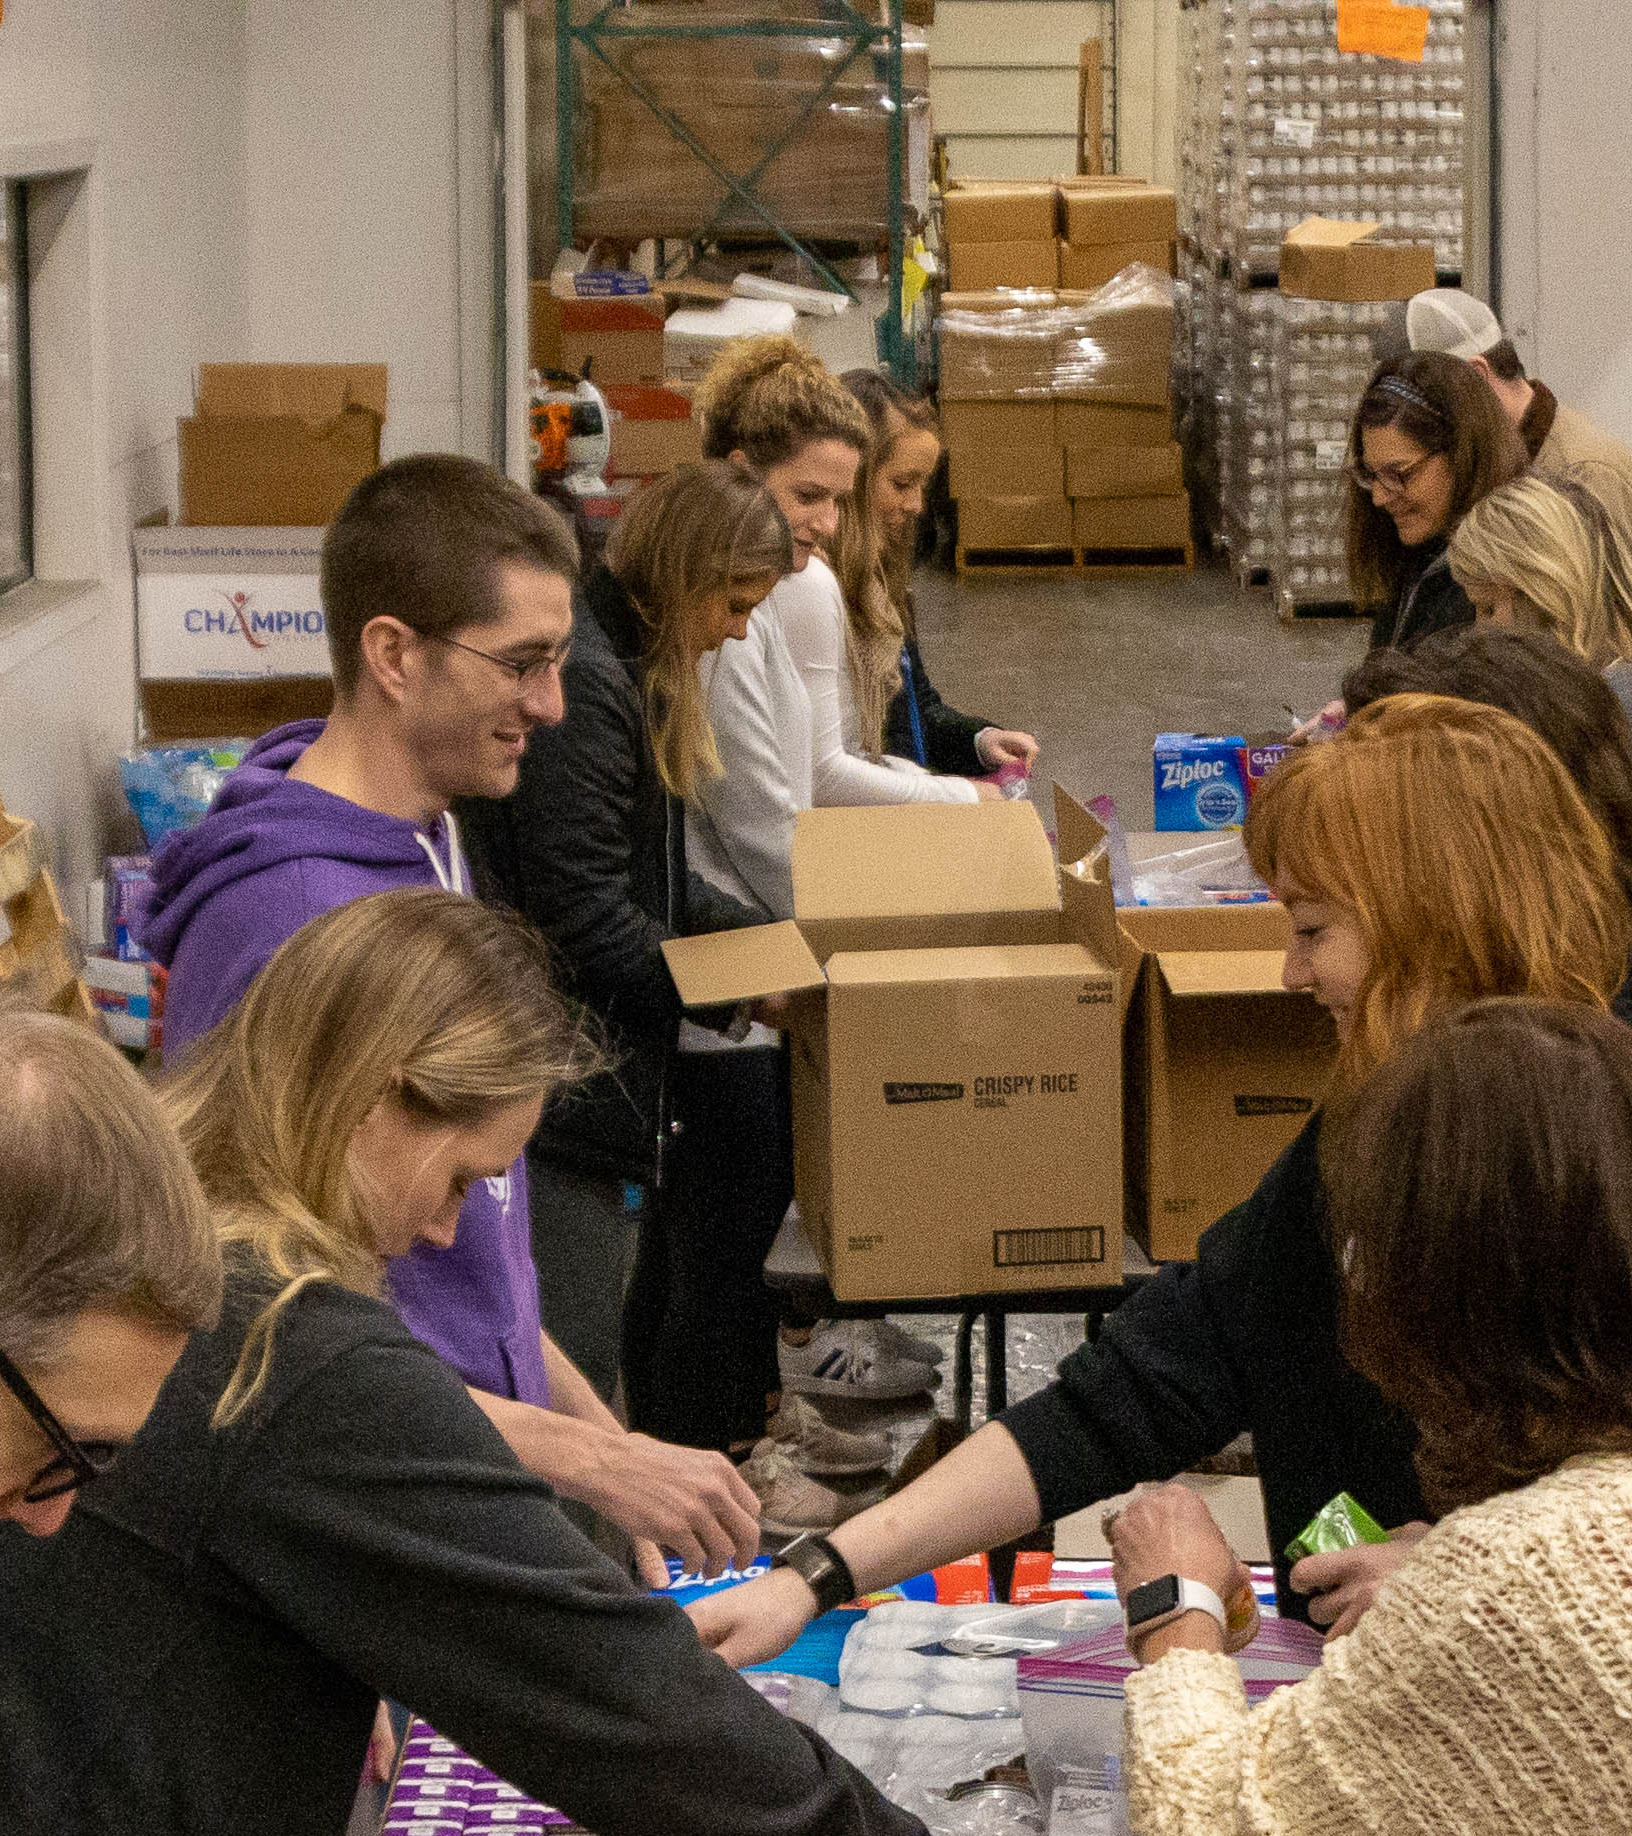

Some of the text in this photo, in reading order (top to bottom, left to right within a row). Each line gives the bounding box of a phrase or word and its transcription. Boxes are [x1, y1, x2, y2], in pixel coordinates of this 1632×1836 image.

[1161, 759, 1226, 790] Ziploc
[973, 1073, 1078, 1097] CRISPY RICE
[1057, 1794, 1103, 1814] Ziploc
